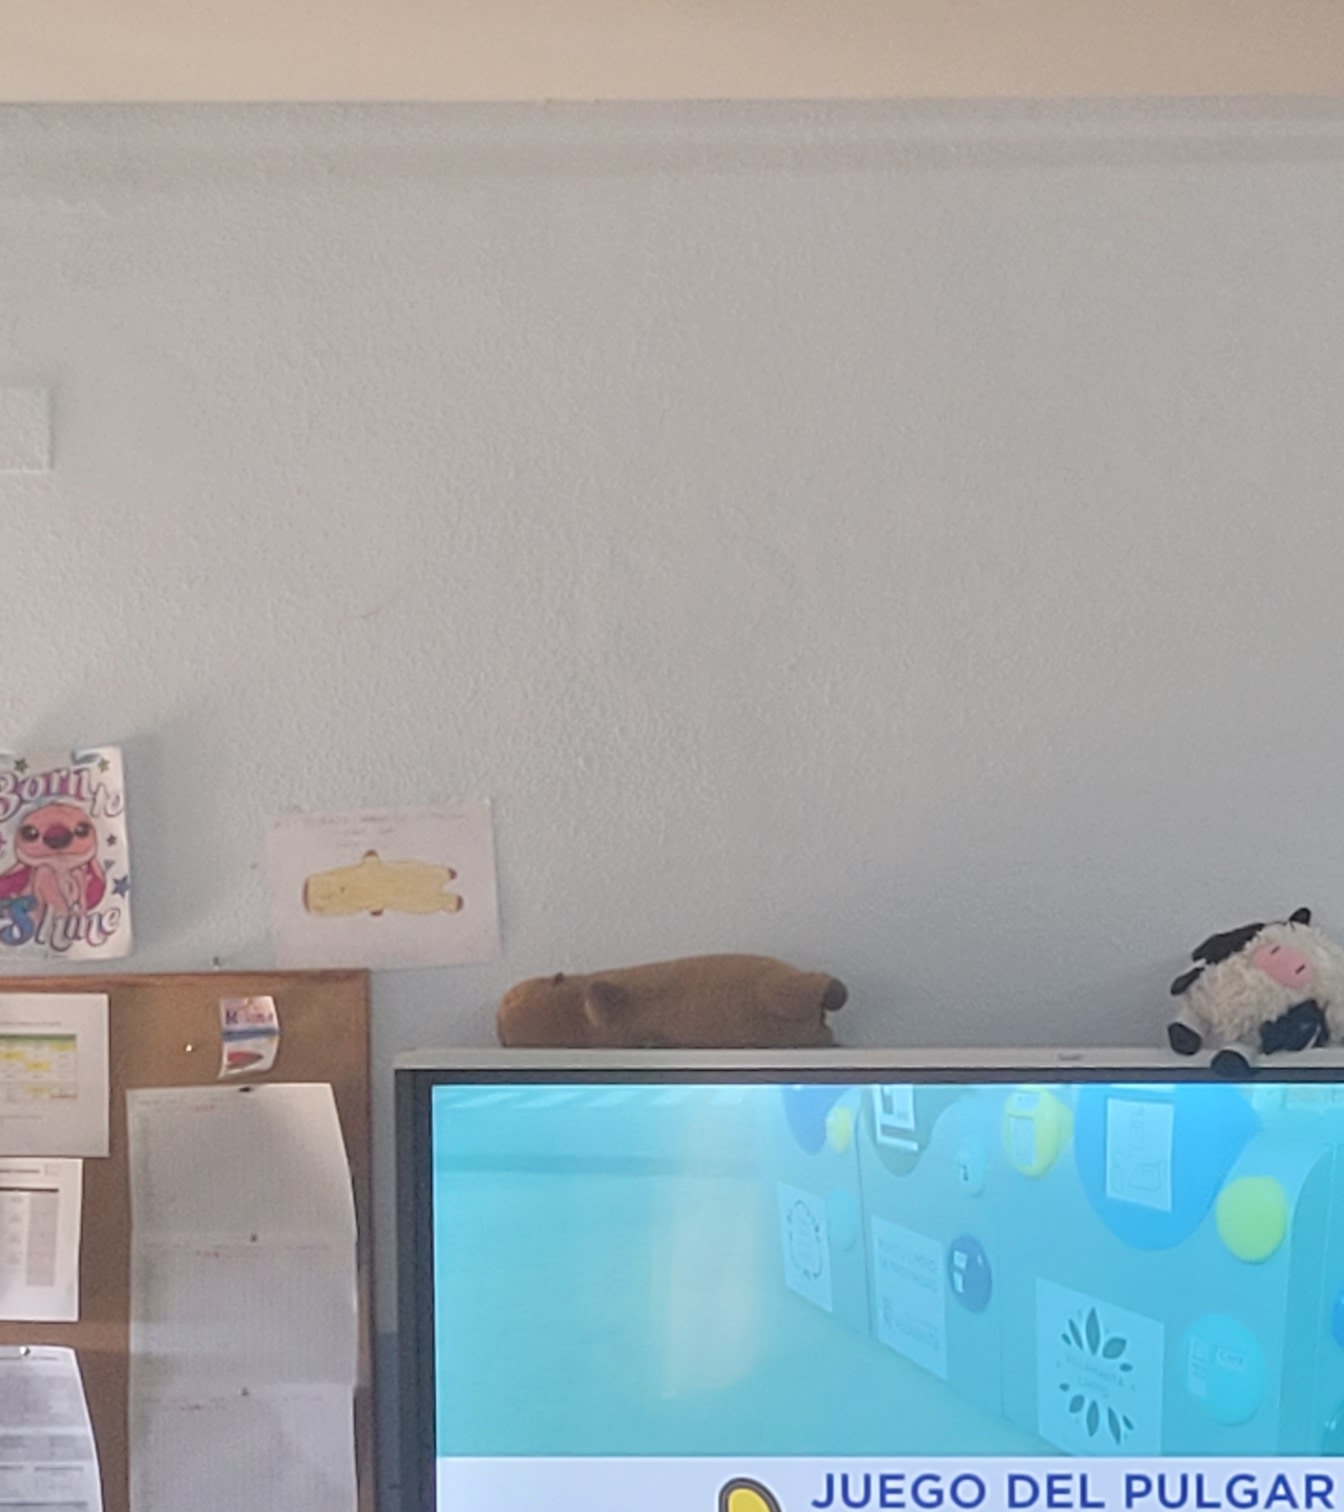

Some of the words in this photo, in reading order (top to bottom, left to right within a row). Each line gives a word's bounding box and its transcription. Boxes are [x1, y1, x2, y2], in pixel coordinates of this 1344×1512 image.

[811, 1473, 987, 1511] JUEGO
[1007, 1473, 1106, 1511] DEL
[1124, 1473, 1336, 1511] PULGAR
